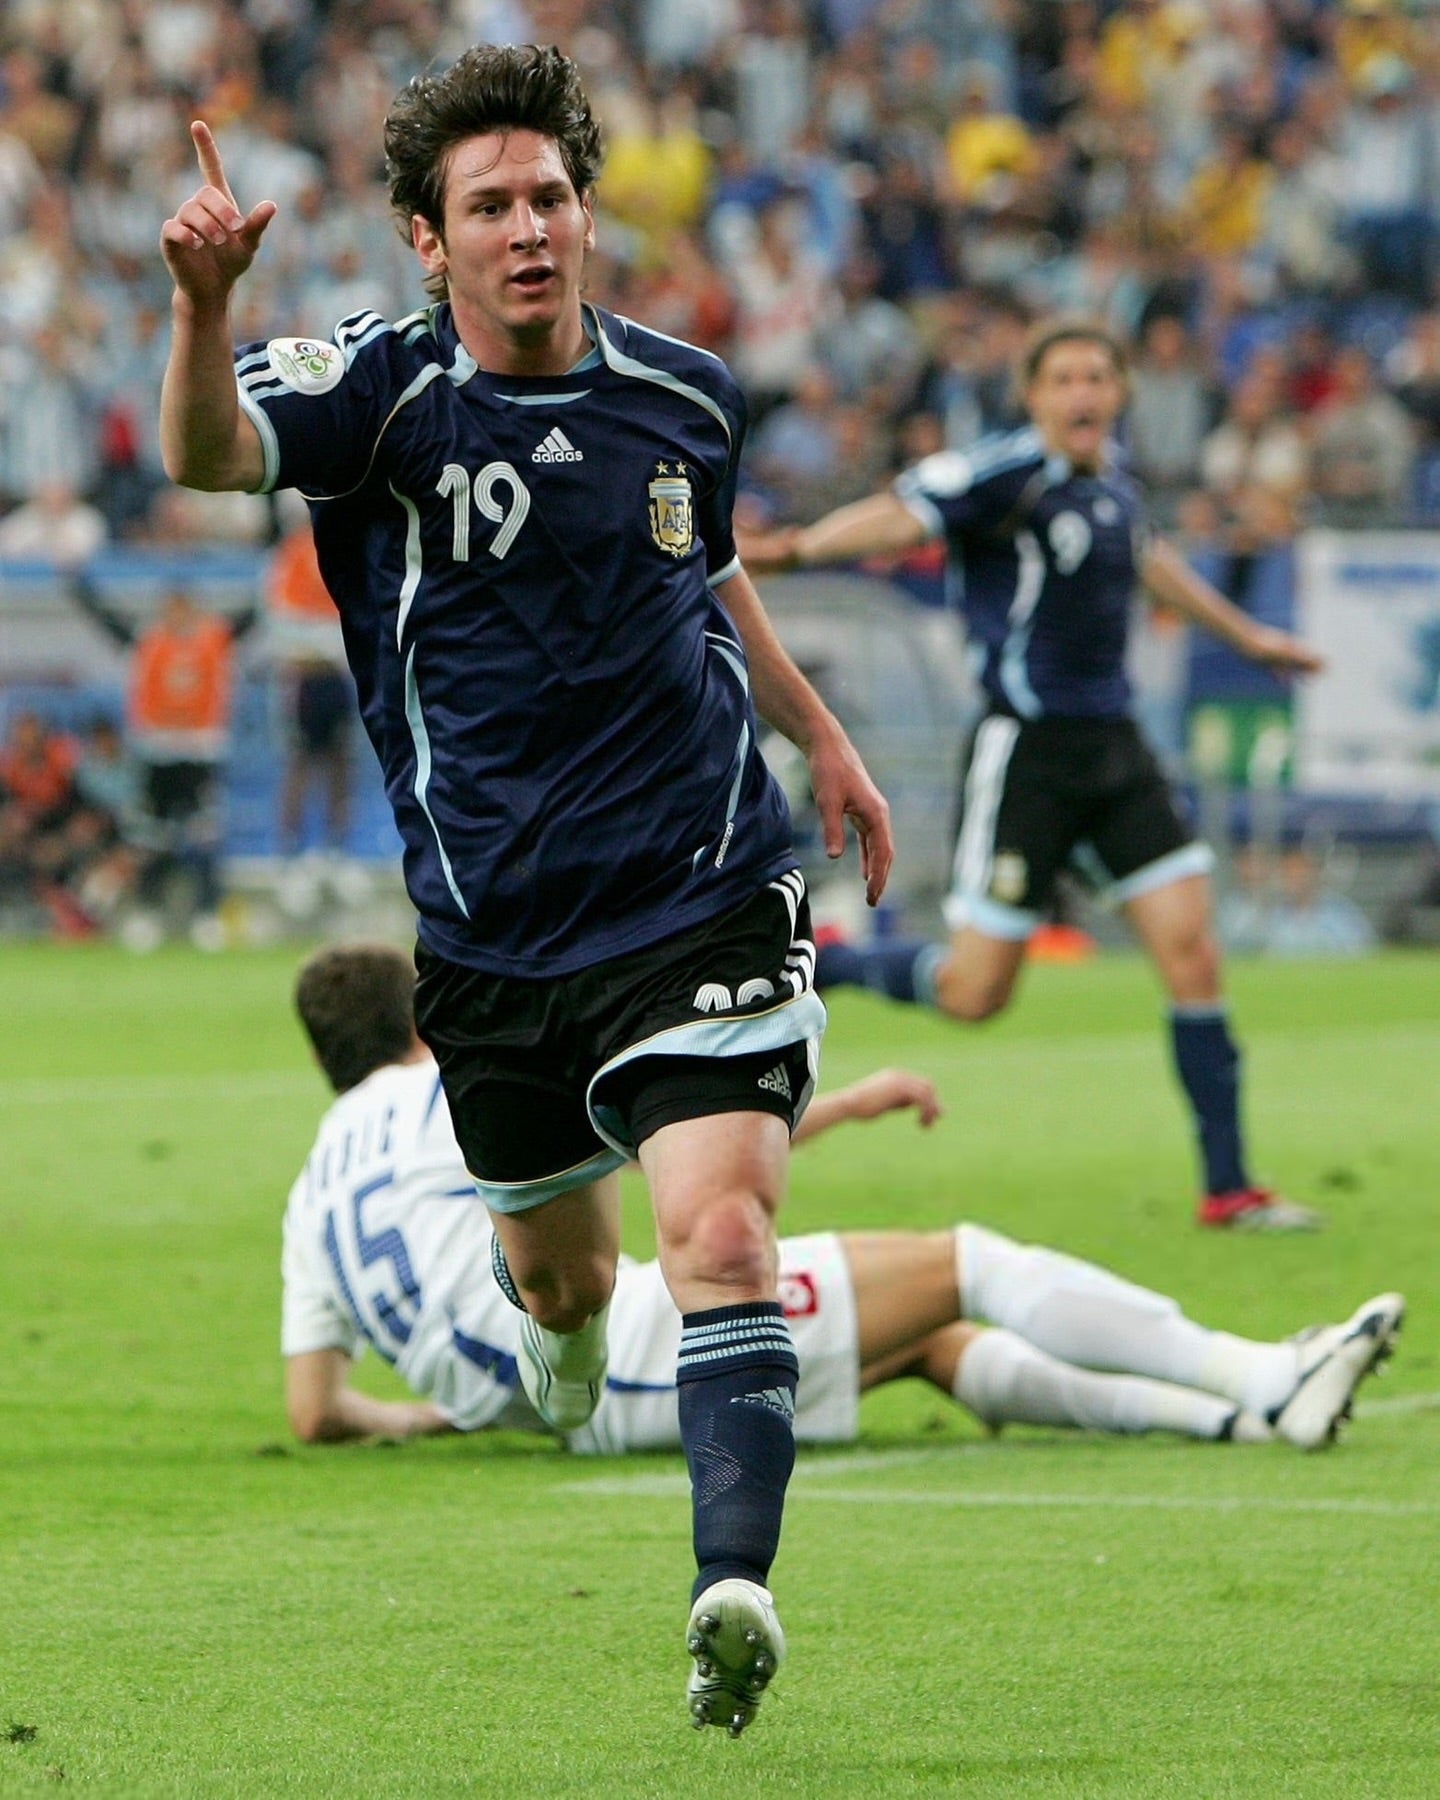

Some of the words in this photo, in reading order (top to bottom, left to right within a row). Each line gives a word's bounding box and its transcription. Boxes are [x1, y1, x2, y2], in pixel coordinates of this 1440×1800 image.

[531, 449, 584, 463] adidas
[435, 461, 531, 562] 19
[1048, 509, 1093, 576] 9
[757, 1077, 792, 1102] adida
